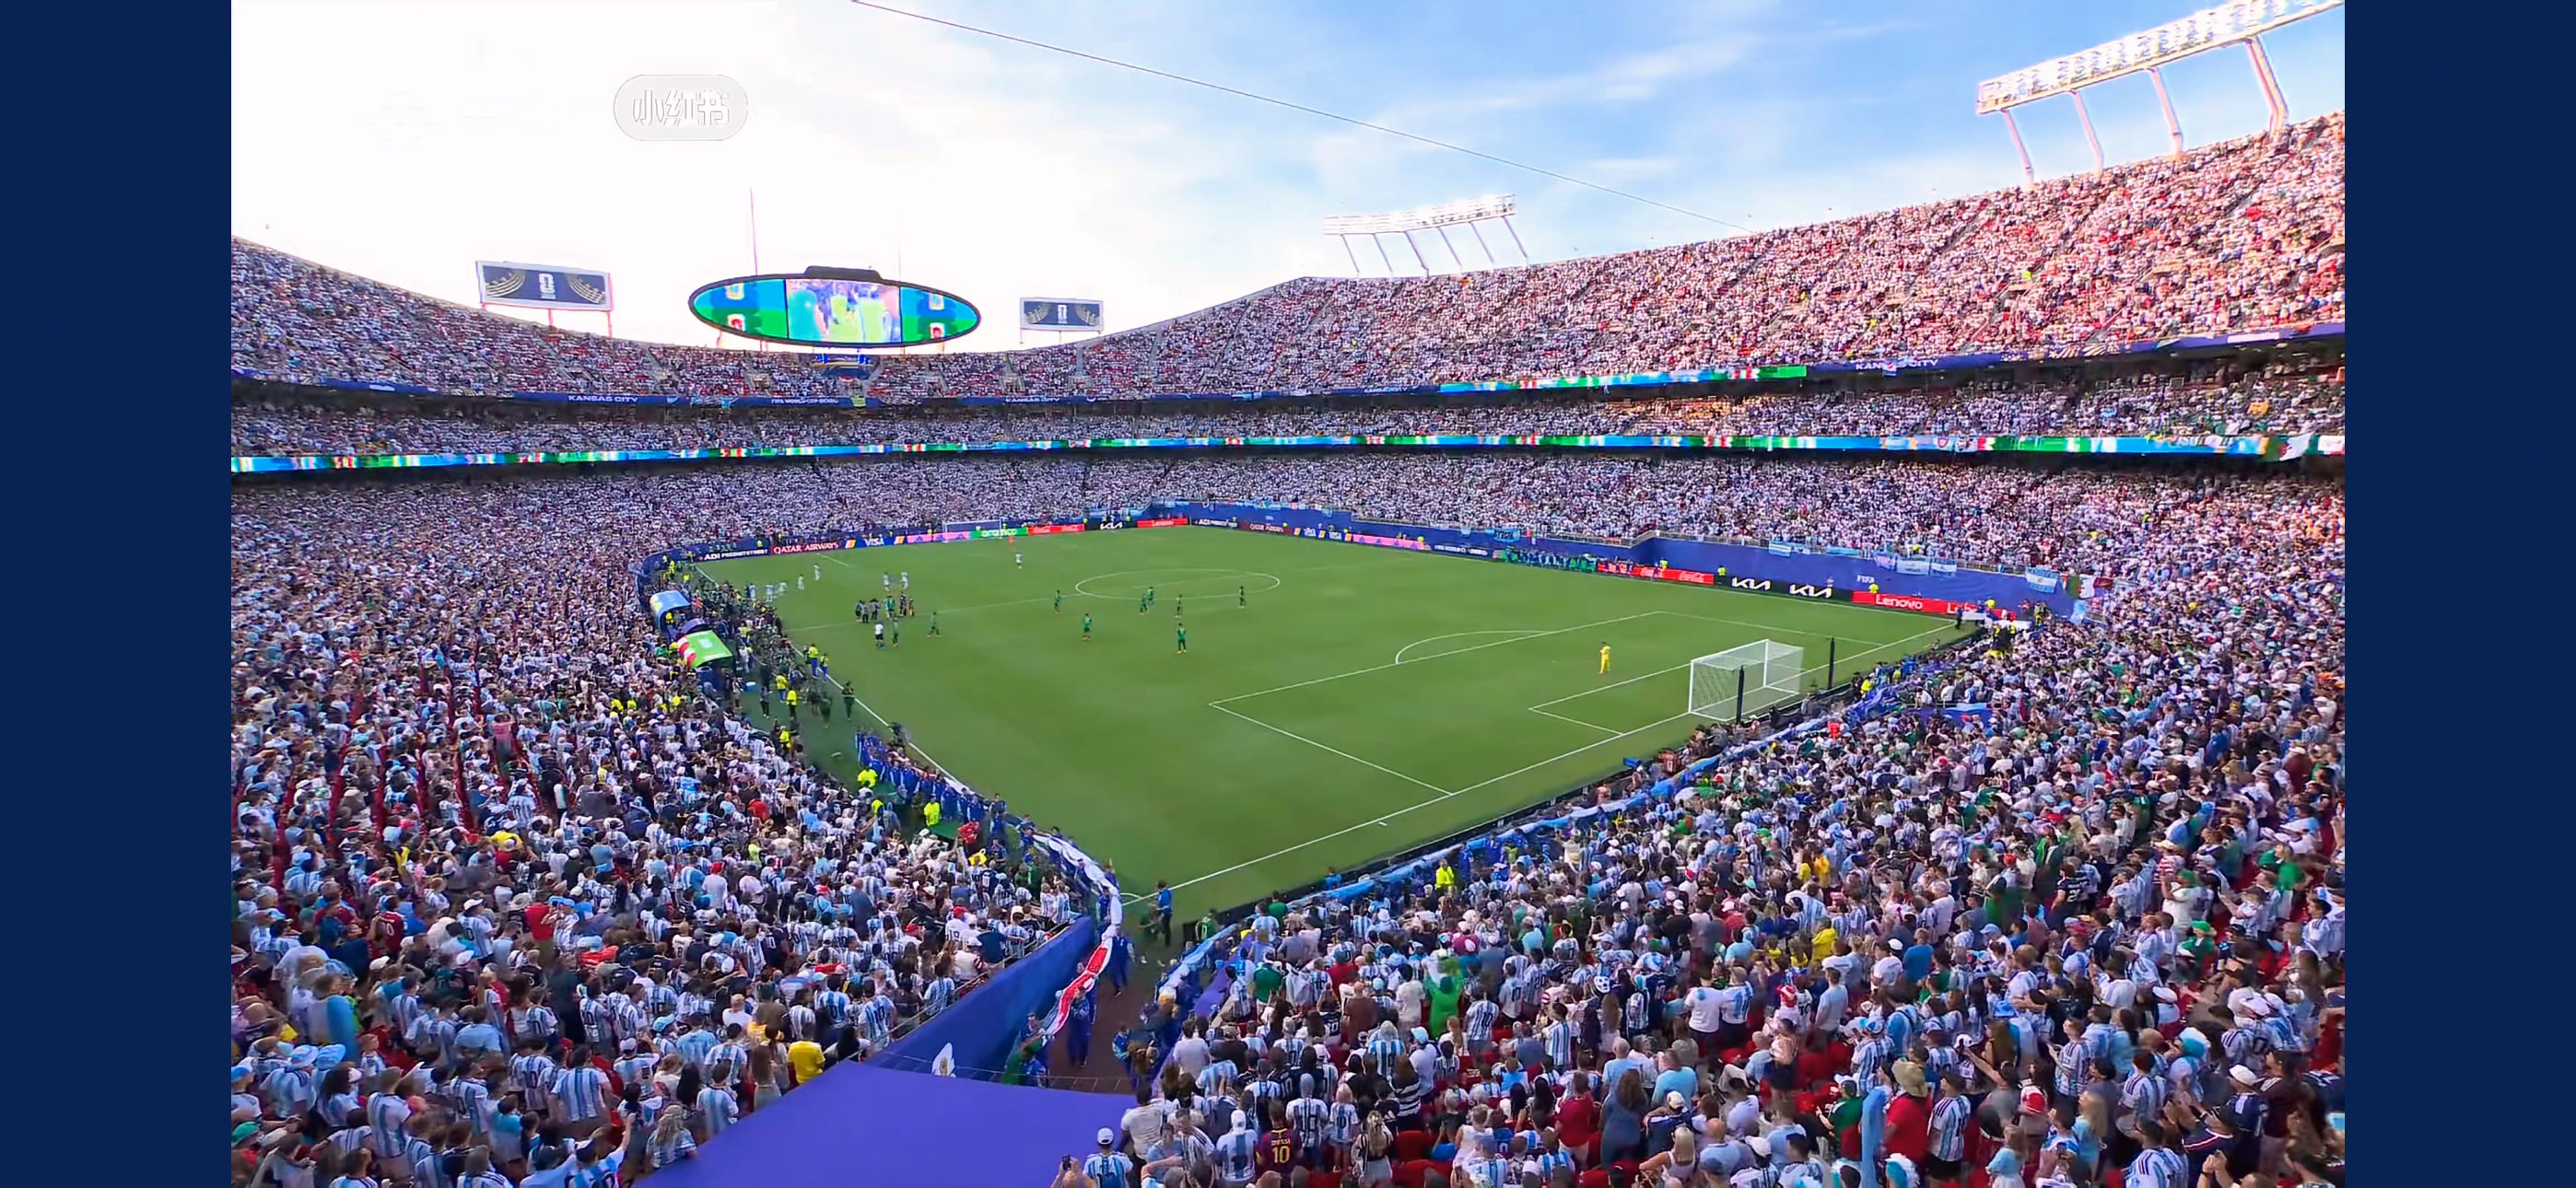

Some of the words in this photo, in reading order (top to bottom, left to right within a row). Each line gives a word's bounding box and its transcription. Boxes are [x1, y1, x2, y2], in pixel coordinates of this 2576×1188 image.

[568, 394, 613, 402] KANSAS
[773, 545, 802, 554] QATAR
[804, 542, 839, 551] AIRWAYS
[863, 537, 884, 547] VISA
[703, 553, 720, 561] ADI
[1731, 577, 1771, 591] KIA
[1789, 584, 1832, 599] KIA
[1876, 594, 1923, 610] Lenovo
[1272, 1146, 1290, 1163] 10
